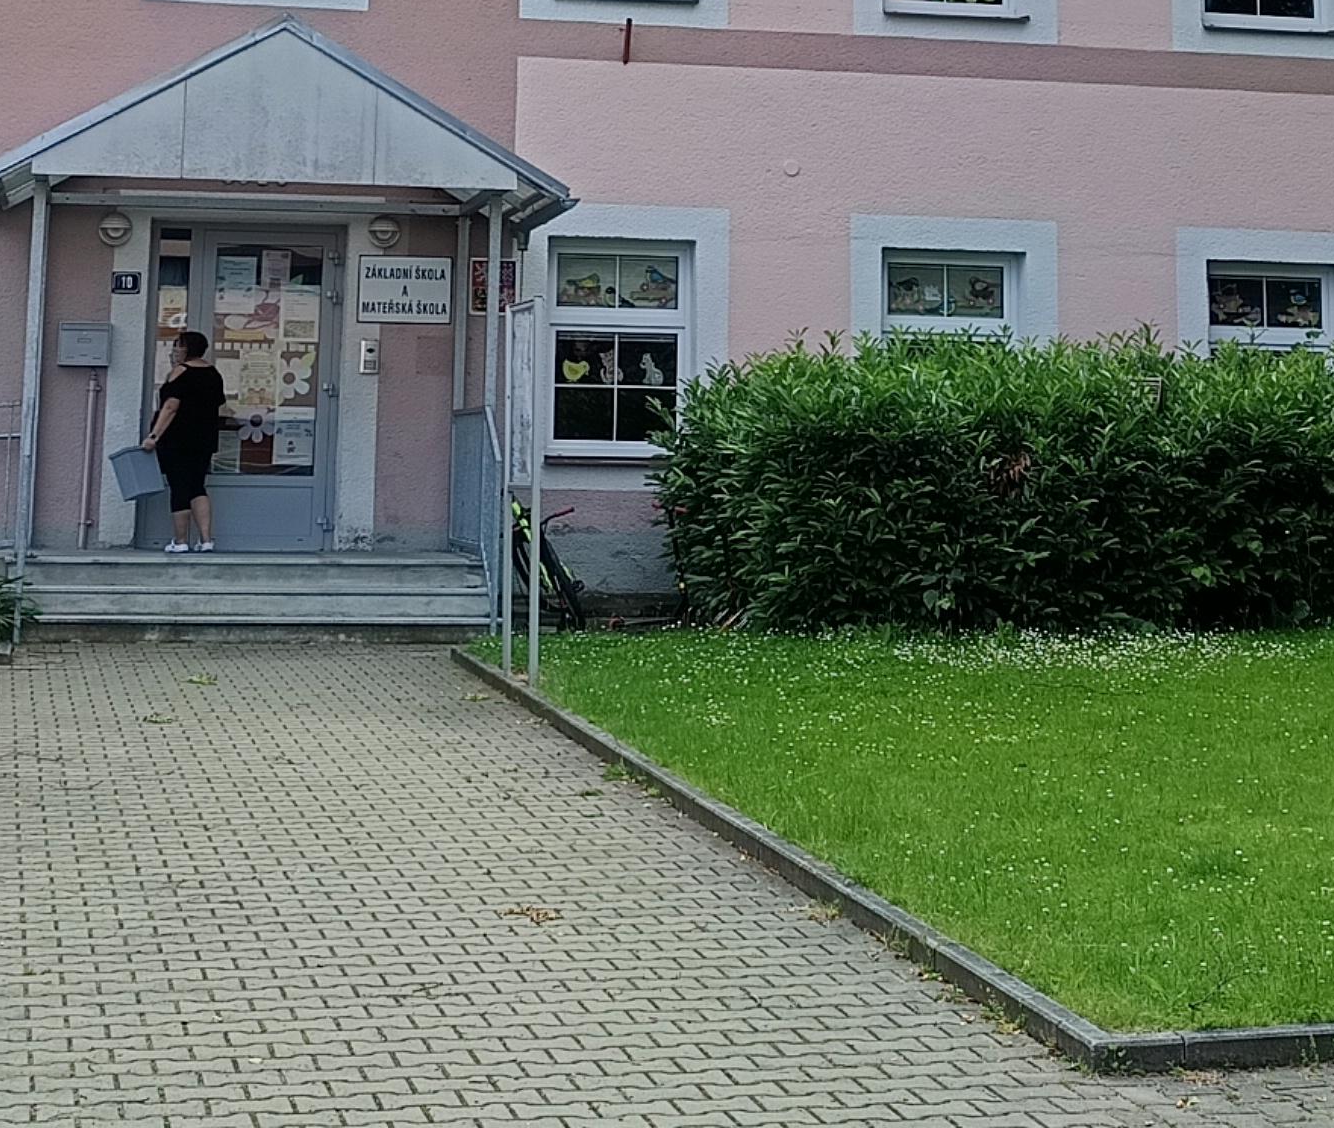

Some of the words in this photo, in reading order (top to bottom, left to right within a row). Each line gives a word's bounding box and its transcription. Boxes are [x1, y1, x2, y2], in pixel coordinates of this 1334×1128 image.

[365, 264, 412, 279] ZÁKLADNÍ
[415, 265, 446, 280] ŠKOLA
[121, 275, 133, 289] 10
[401, 284, 409, 297] A
[362, 299, 413, 314] MATEŘSKÁ
[416, 300, 447, 315] ŠKOLA
